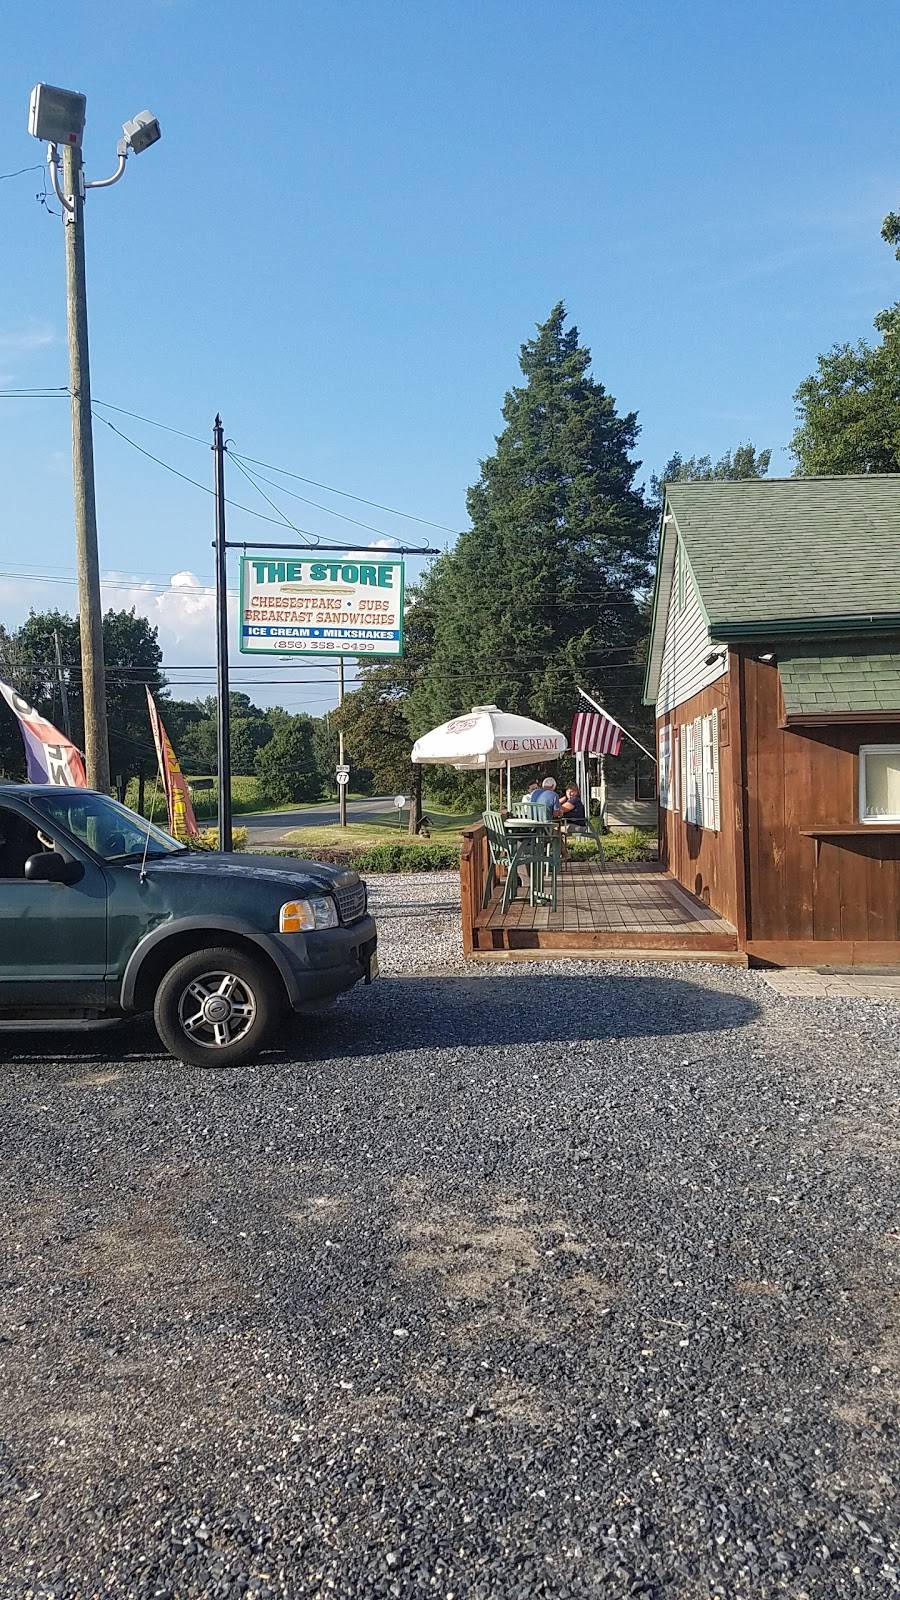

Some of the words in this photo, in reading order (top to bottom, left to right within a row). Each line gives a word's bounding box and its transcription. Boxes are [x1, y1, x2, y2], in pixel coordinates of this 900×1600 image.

[252, 562, 302, 584] THE
[310, 563, 393, 588] STORE
[250, 596, 342, 610] CHEESESTEAKS
[358, 600, 390, 611] SUBS
[244, 610, 313, 623] BREAKFAST
[316, 612, 395, 626] SANDWICHES
[248, 627, 267, 636] ICE
[270, 628, 310, 637] CREAM
[323, 629, 395, 639] MILKSHAKES
[273, 641, 307, 649] (856)
[310, 641, 375, 651] 358-0499
[500, 739, 519, 751] ICE
[521, 737, 558, 751] CREAM
[338, 774, 348, 782] 77
